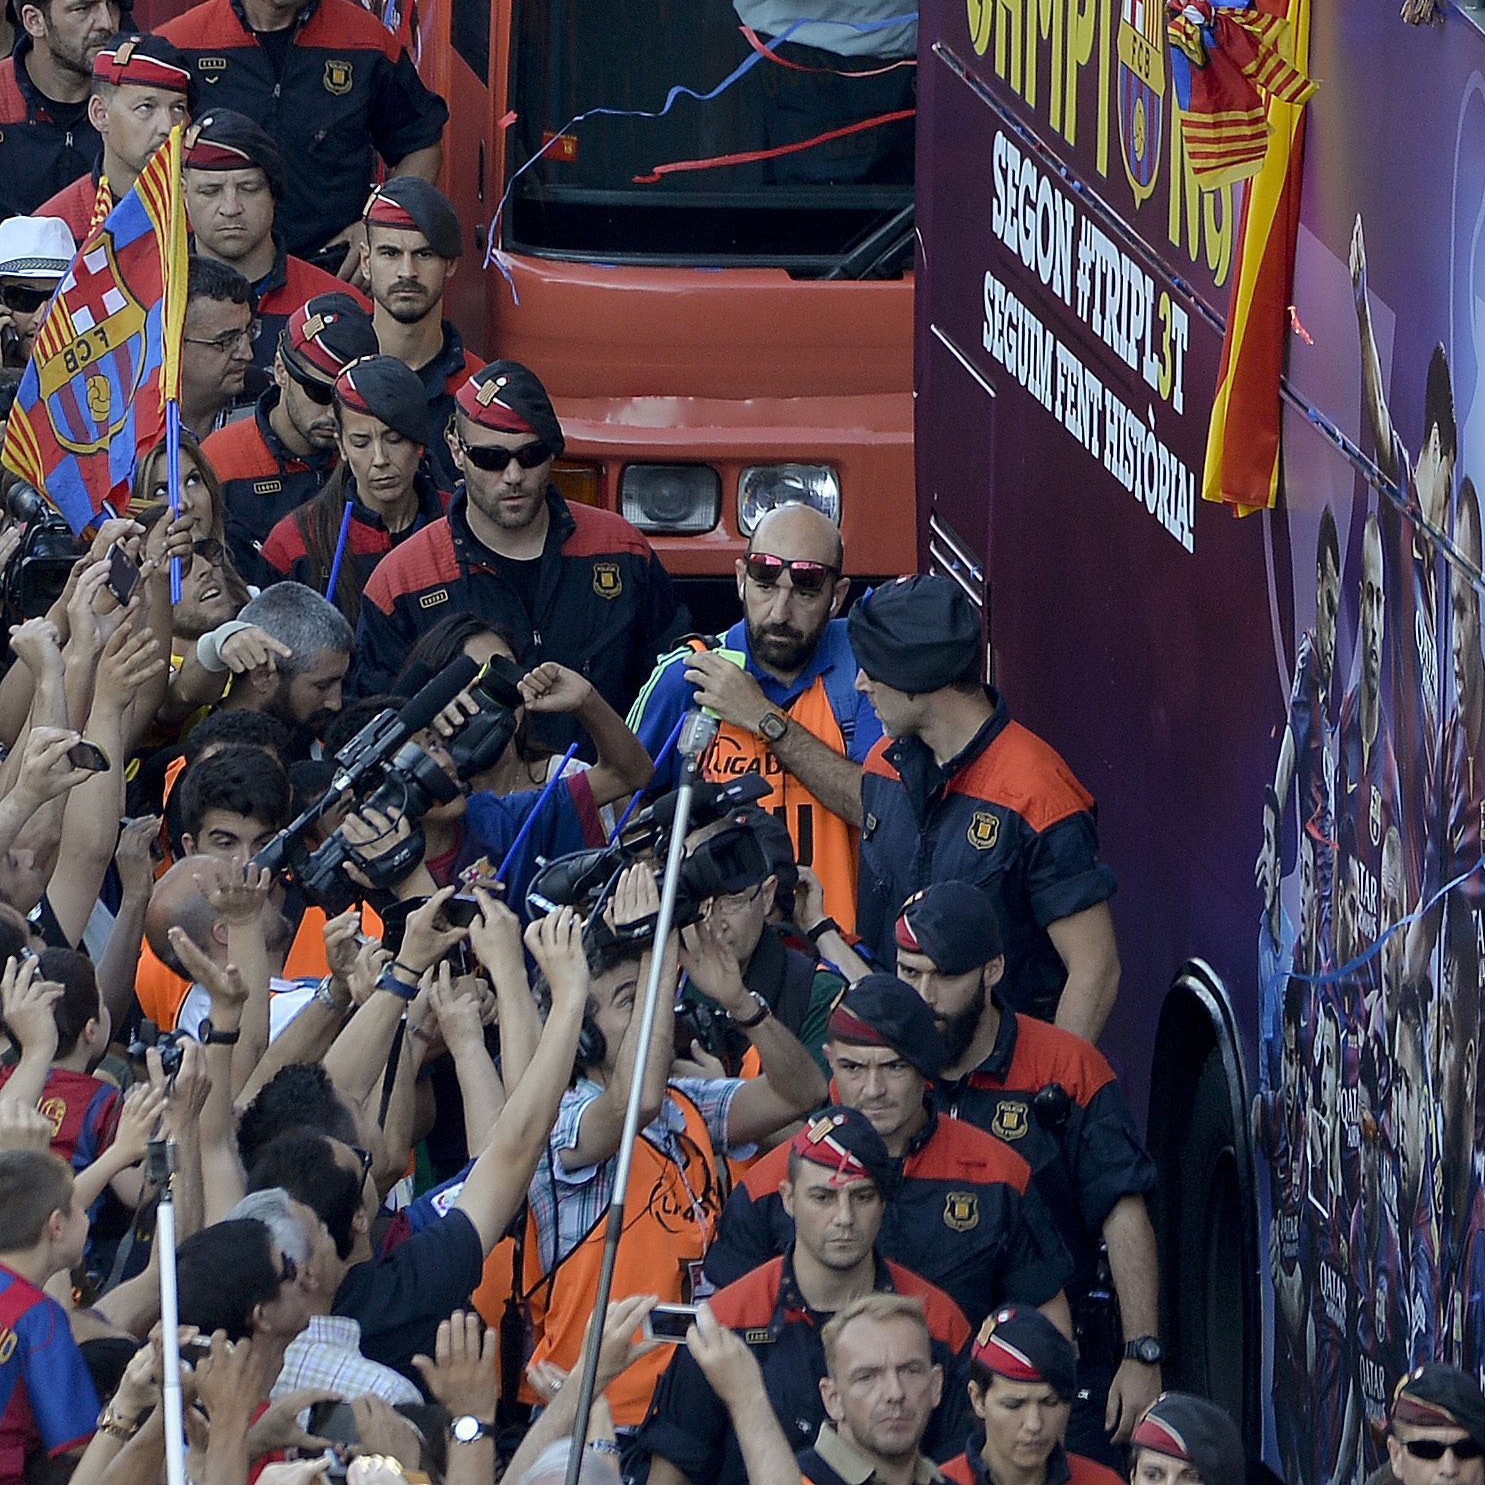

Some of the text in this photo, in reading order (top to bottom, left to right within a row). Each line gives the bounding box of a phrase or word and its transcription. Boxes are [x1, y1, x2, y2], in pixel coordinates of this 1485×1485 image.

[1131, 35, 1151, 79] FCB
[991, 130, 1189, 415] SEGON #TRIPL3T
[982, 270, 1195, 555] SEGUIM FENT HISTÒRIA!
[1318, 1261, 1347, 1312] QATAR
[1358, 1353, 1385, 1404] QATAR
